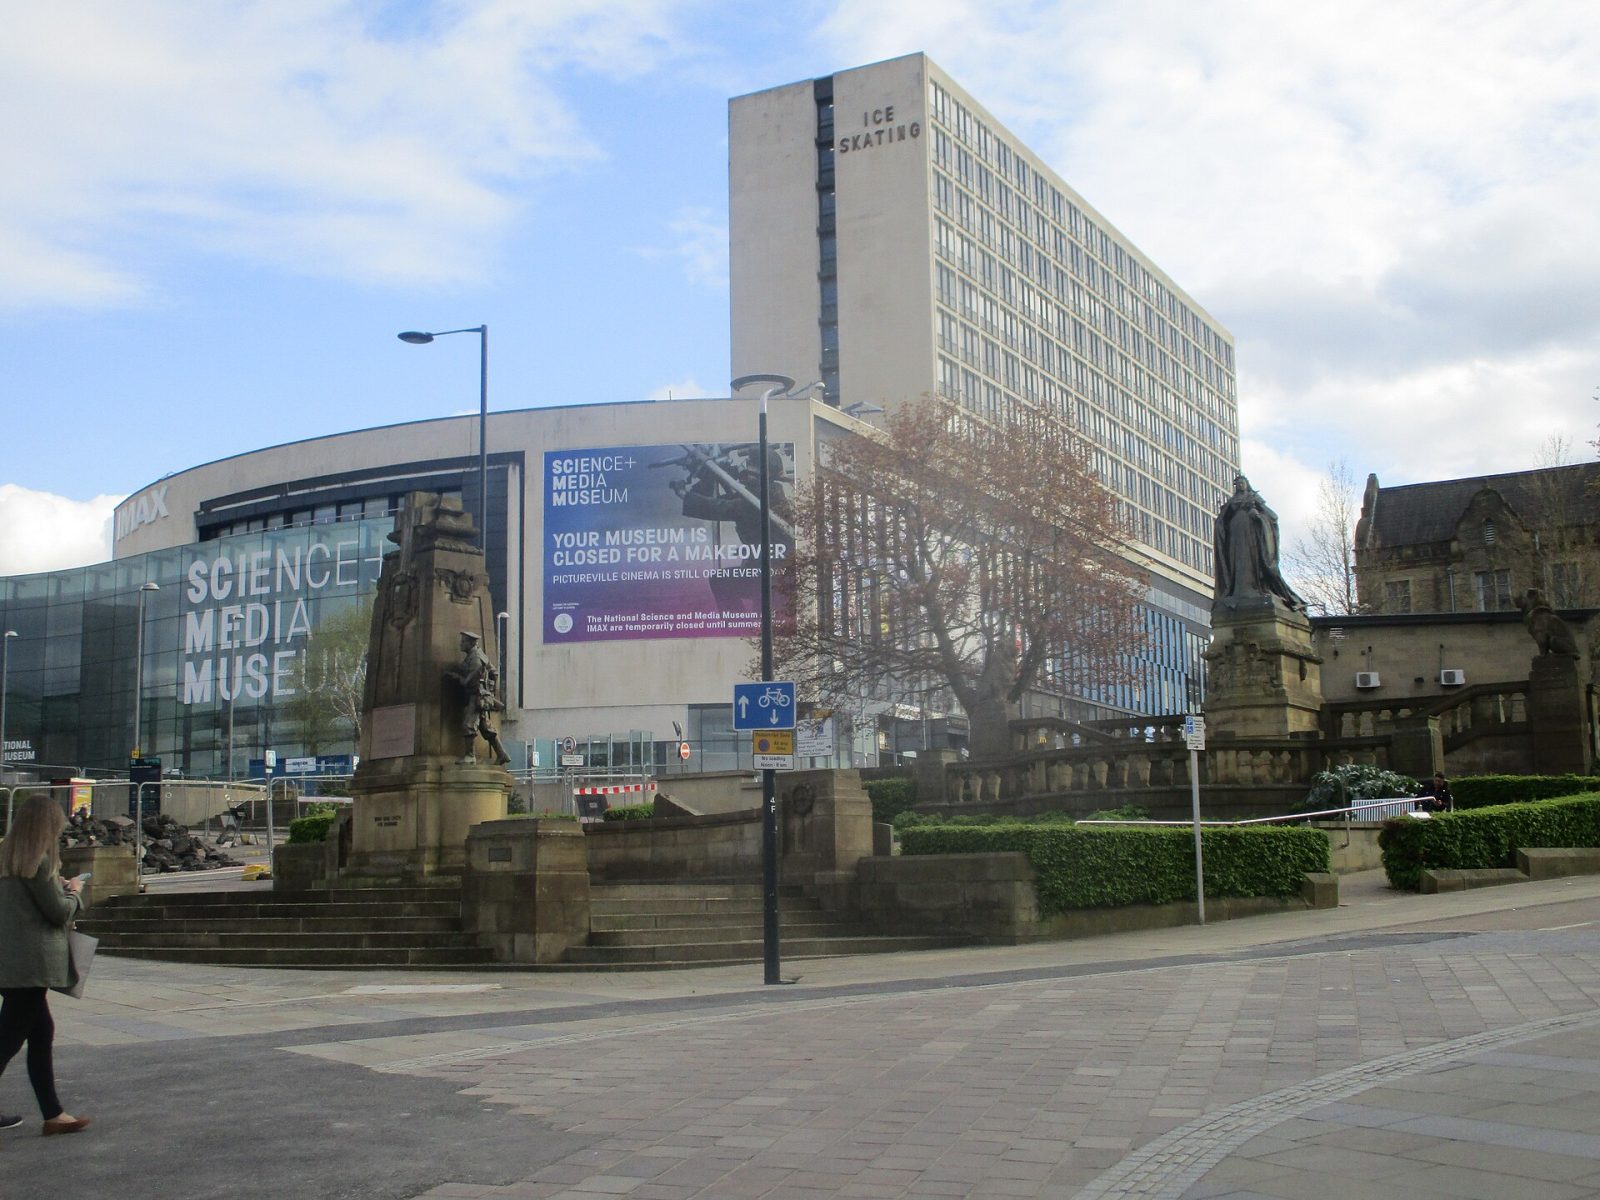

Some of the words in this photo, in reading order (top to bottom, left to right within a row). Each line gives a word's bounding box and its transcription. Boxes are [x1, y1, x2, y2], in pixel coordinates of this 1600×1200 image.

[864, 105, 894, 127] ICE
[839, 121, 920, 153] SKATING
[552, 456, 637, 474] SCIENCE+
[552, 473, 607, 490] MEDIA
[552, 488, 628, 506] MUSEUM
[117, 485, 169, 541] IMAX
[553, 531, 600, 549] YOUR
[605, 528, 684, 546] MUSEUM
[691, 527, 707, 543] IS
[553, 548, 621, 567] CLOSED
[627, 547, 662, 563] FOR
[667, 546, 680, 561] A
[553, 571, 618, 584] PICTUREVILLE
[621, 571, 660, 581] CINEMA
[662, 570, 672, 580] IS
[674, 569, 700, 579] STILL
[703, 568, 730, 578] OPEN
[185, 597, 313, 655] MEDIA
[587, 615, 602, 624] The
[604, 613, 639, 623] National
[640, 612, 674, 621] Science
[677, 612, 692, 620] and
[694, 611, 721, 620] Media
[722, 611, 758, 620] Museum
[587, 624, 608, 633] IMAX
[625, 622, 674, 633] temporarily
[676, 621, 704, 629] closed
[706, 620, 726, 629] until
[4, 740, 31, 750] TIONAL
